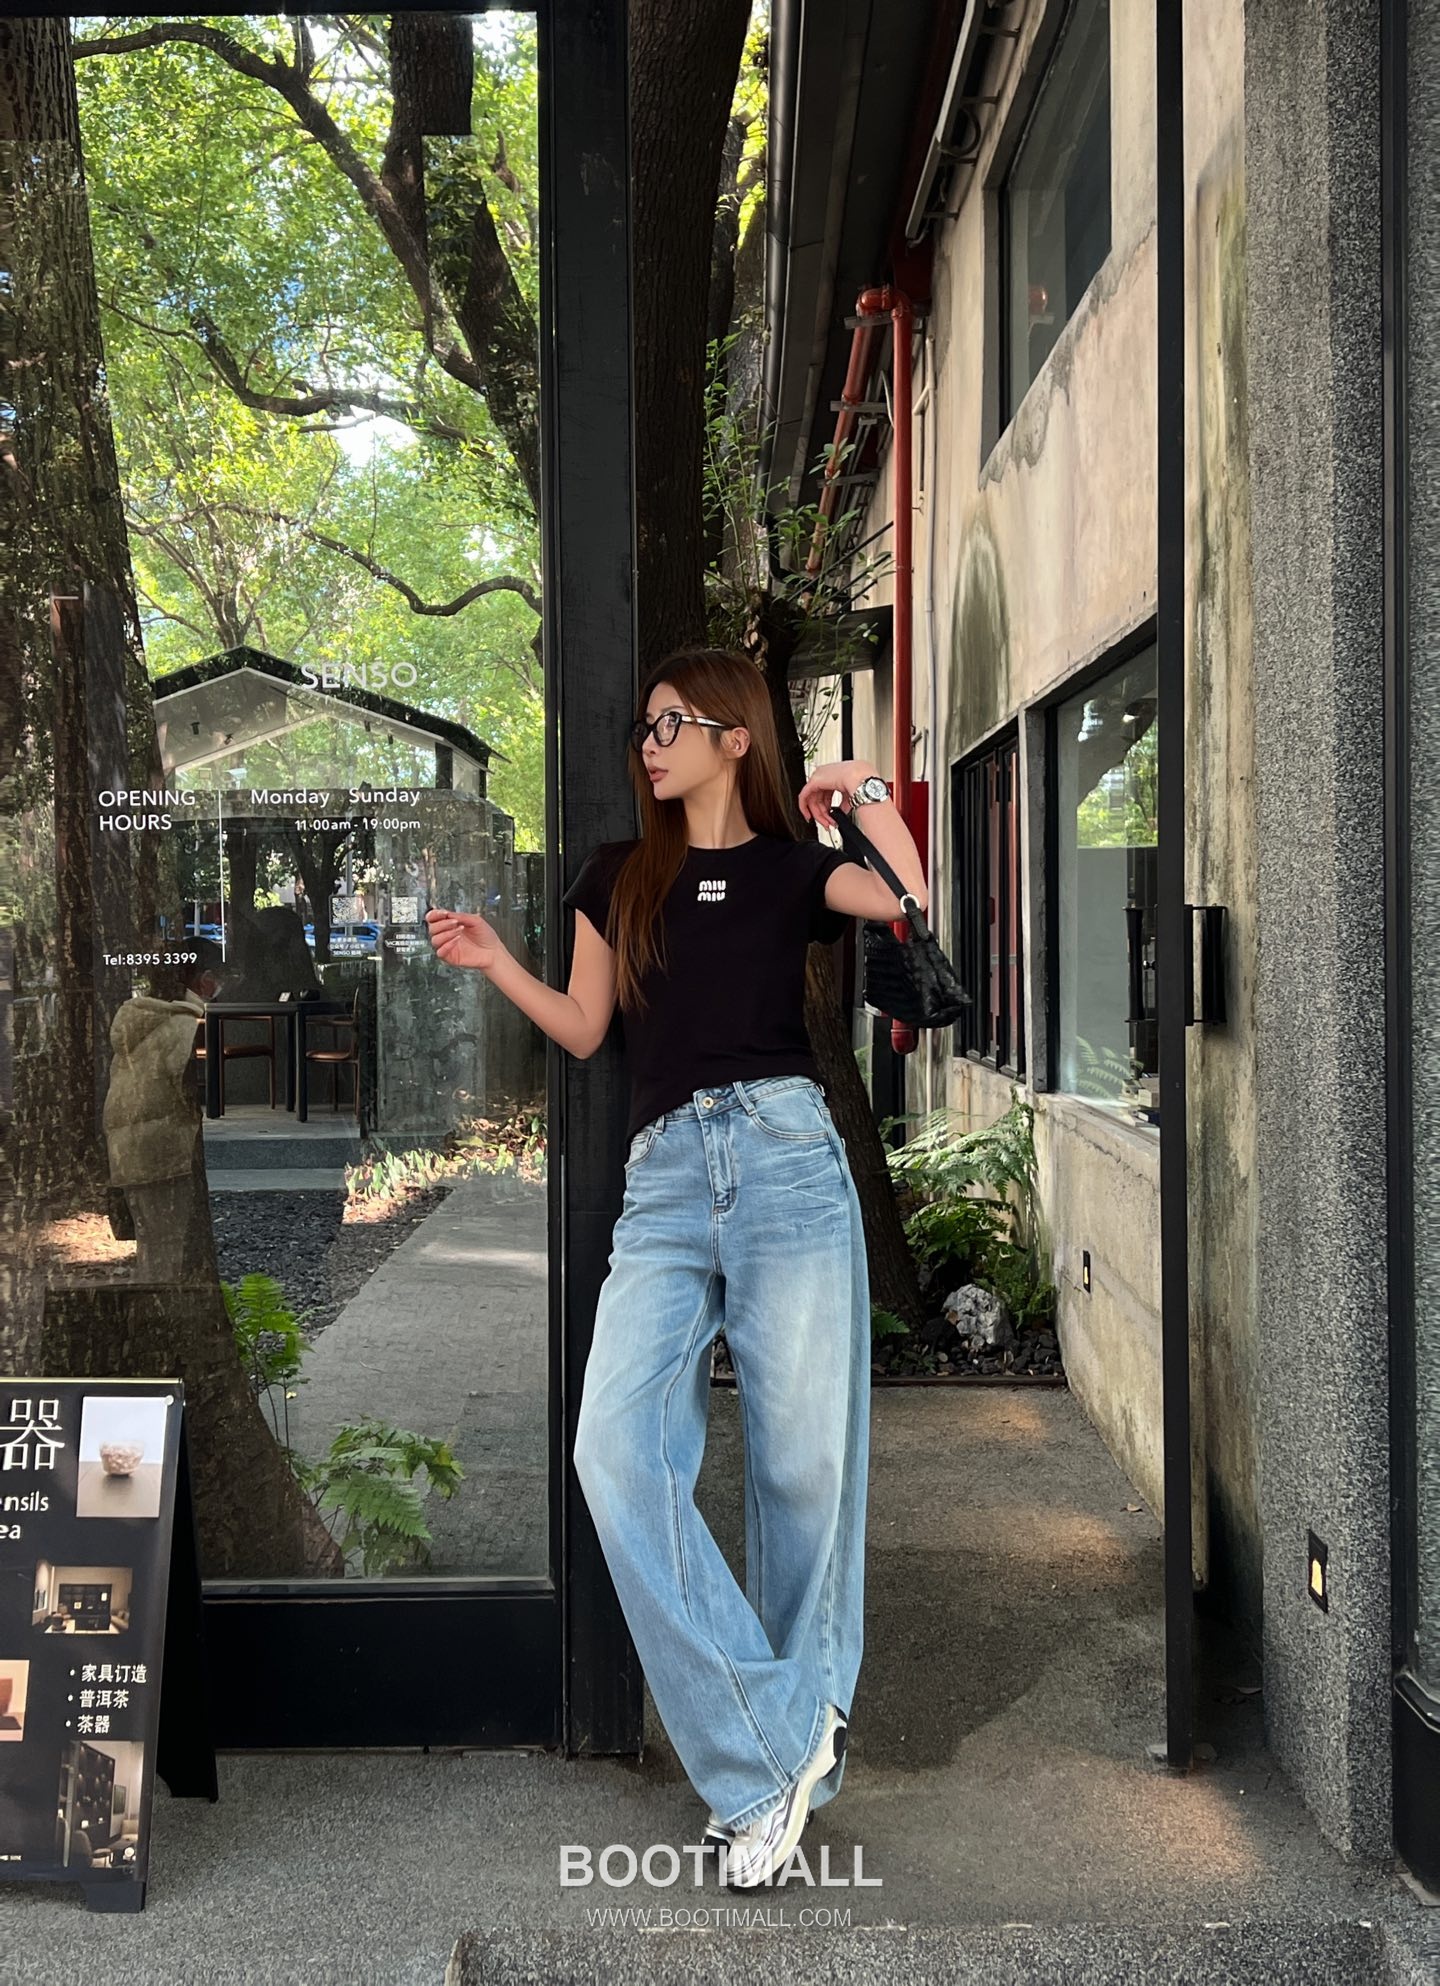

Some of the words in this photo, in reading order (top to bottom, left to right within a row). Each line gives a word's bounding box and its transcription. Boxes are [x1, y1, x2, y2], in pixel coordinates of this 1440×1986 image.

[301, 661, 418, 689] SENSO
[98, 789, 196, 807] OPENING
[251, 788, 330, 808] Monday
[349, 787, 420, 807] Sunday
[99, 814, 172, 831] HOURS
[363, 818, 421, 832] 19:00pm
[103, 953, 160, 966] Tel:8395
[163, 952, 198, 965] 3399
[0, 1398, 66, 1471] 器
[81, 1663, 147, 1684] 家具订造
[79, 1688, 130, 1709] 普洱茶
[77, 1714, 111, 1734] 茶器
